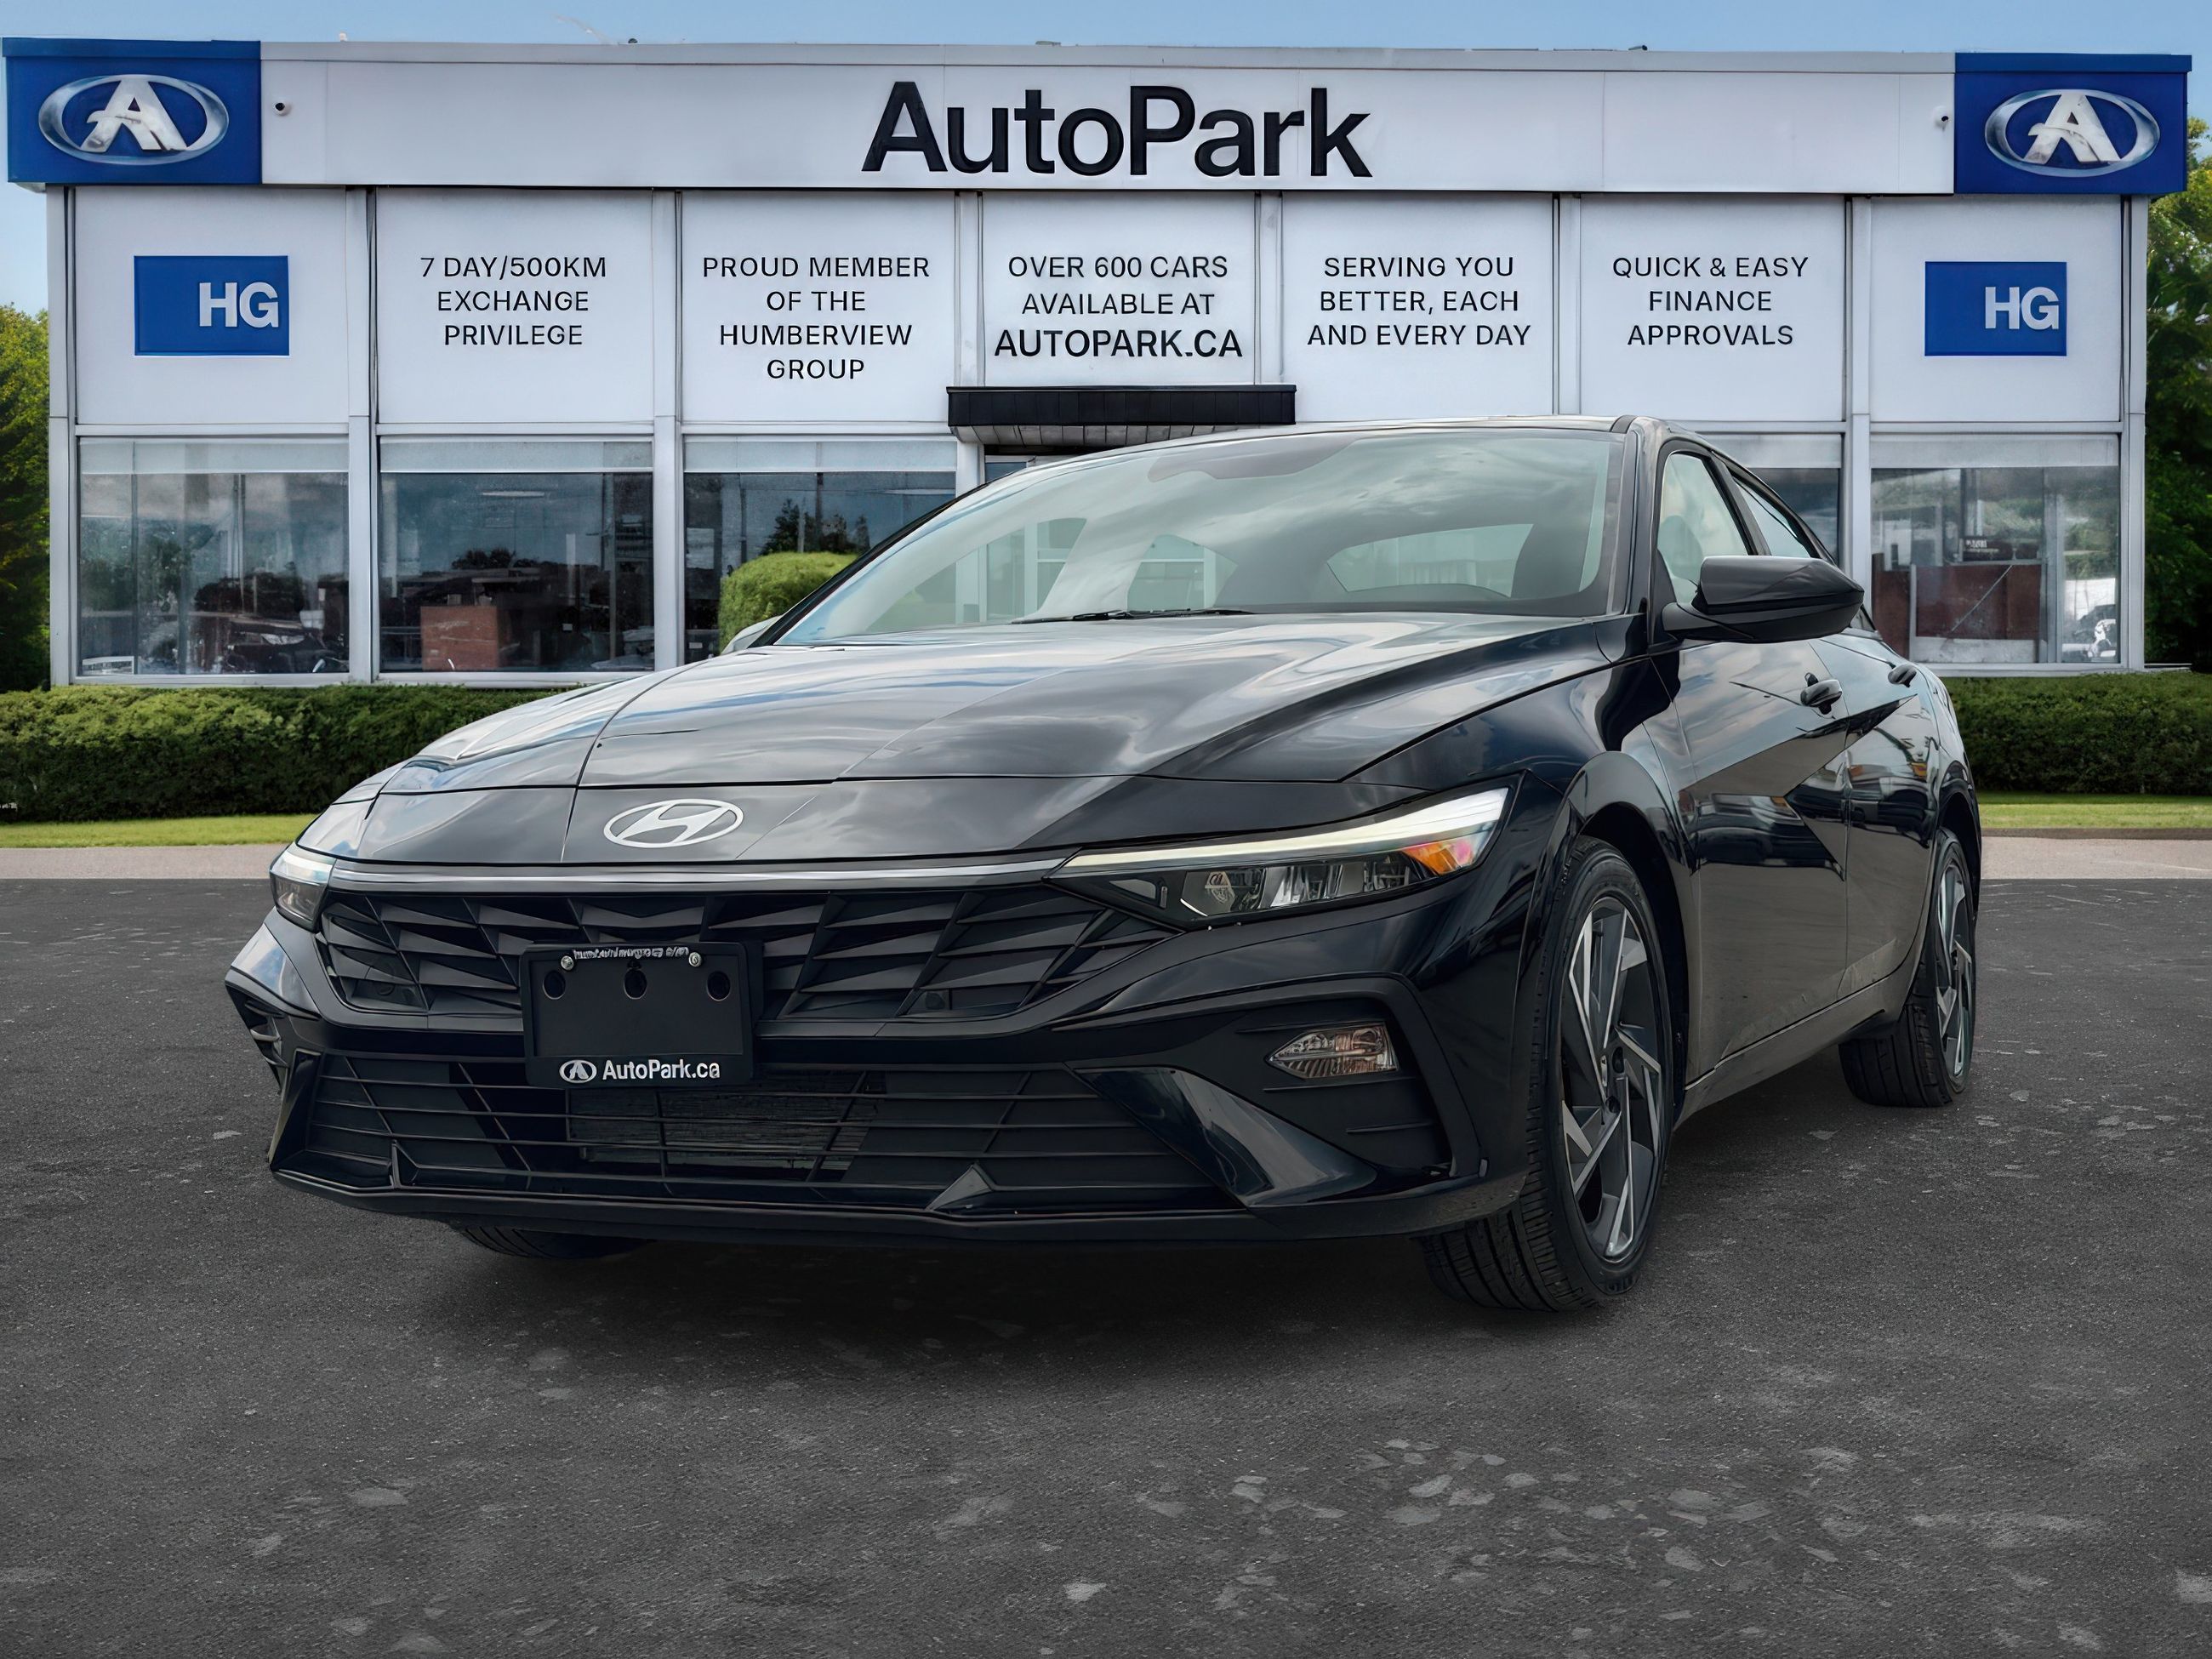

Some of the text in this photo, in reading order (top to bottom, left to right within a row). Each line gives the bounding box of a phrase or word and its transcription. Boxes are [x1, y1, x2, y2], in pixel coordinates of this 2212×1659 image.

[861, 81, 1373, 178] AutoPark
[420, 256, 607, 281] 7 DAY/500KM
[703, 256, 930, 277] PROUD MEMBER
[1008, 256, 1228, 278] OVER 600 CARS
[1324, 256, 1514, 277] SERVING YOU
[1612, 256, 1809, 278] QUICK & EASY
[198, 281, 279, 329] HG
[438, 290, 589, 311] EXCHANGE
[767, 290, 866, 311] OF THE
[1022, 293, 1215, 315] AVAILABLE AT
[1320, 290, 1518, 316] BETTER, EACH
[1649, 290, 1772, 311] FINANCE
[1985, 286, 2060, 330] HG
[444, 324, 583, 345] PRIVILEGE
[720, 324, 913, 345] HUMBERVIEW
[994, 329, 1243, 357] AUTOPARK.CA
[1307, 324, 1531, 345] AND EVERY DAY
[1627, 324, 1793, 345] APPROVALS
[767, 358, 864, 379] GROUP
[601, 1058, 721, 1080] AutoPark.ca
